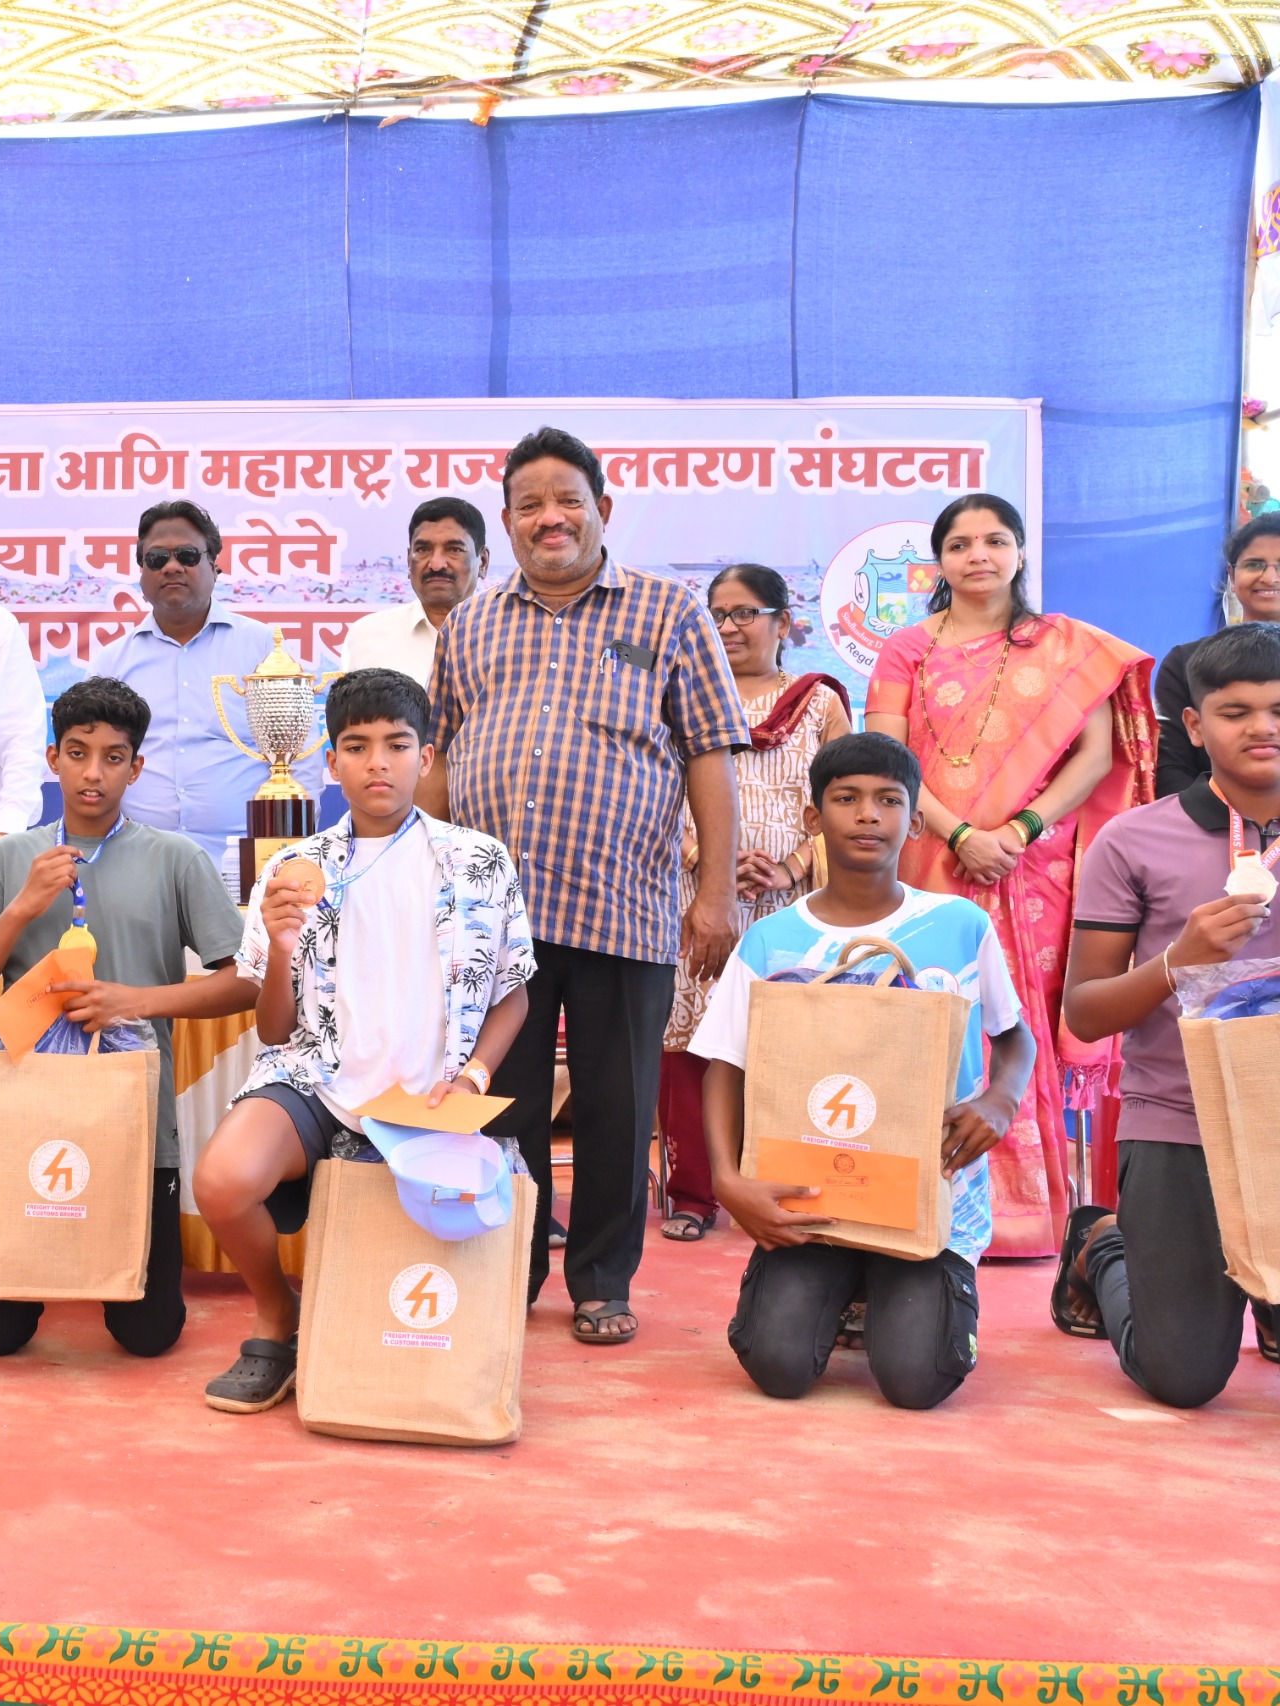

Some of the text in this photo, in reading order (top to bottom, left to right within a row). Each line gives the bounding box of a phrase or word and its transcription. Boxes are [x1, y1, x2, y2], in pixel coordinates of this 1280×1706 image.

[57, 433, 189, 490] आणि
[201, 448, 392, 501] महाराष्ट्र
[599, 447, 775, 488] लतरण
[789, 427, 985, 488] संघटना
[846, 642, 874, 668] Regd.
[802, 1136, 870, 1151] FREIGHT FORWARDER
[384, 1332, 450, 1342] FREIGHT FORWARDER
